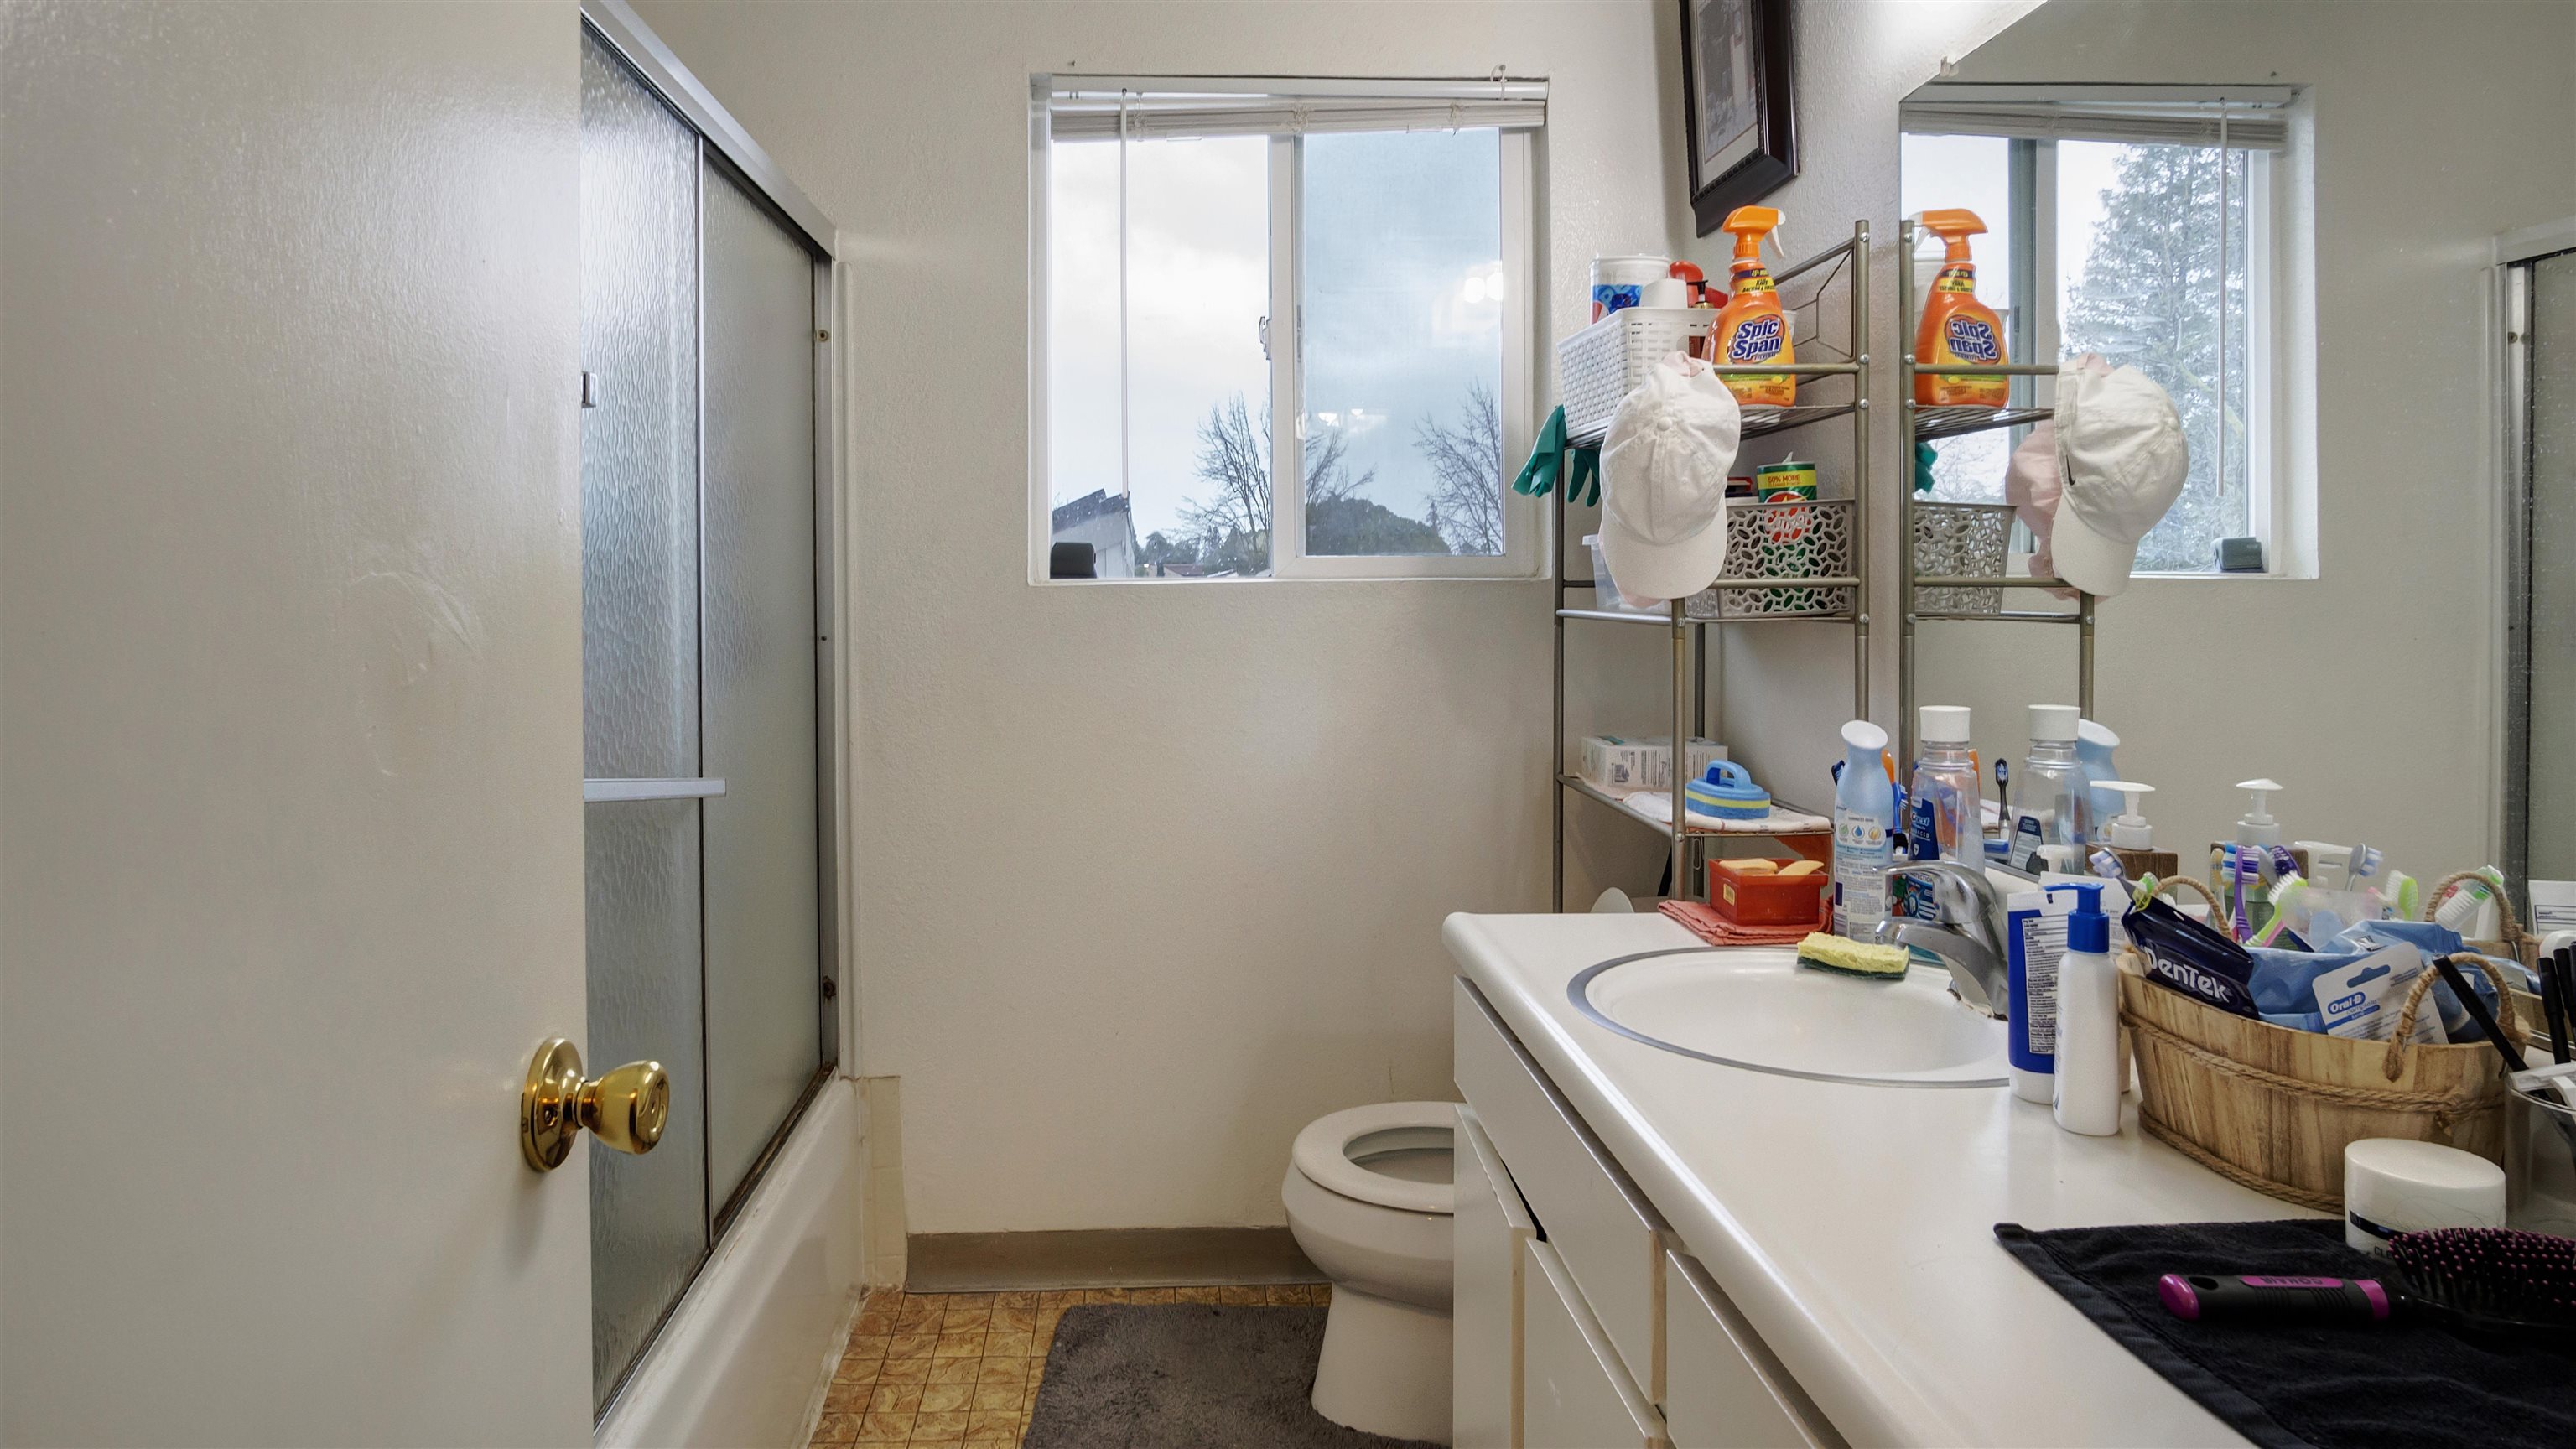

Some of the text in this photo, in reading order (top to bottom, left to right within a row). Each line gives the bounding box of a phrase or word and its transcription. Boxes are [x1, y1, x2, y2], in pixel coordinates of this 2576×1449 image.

[1737, 320, 1779, 340] Spic
[1732, 337, 1781, 359] Span
[1783, 474, 1800, 482] MORE
[2144, 946, 2230, 1003] DenTek
[2329, 994, 2362, 1013] Oral-B
